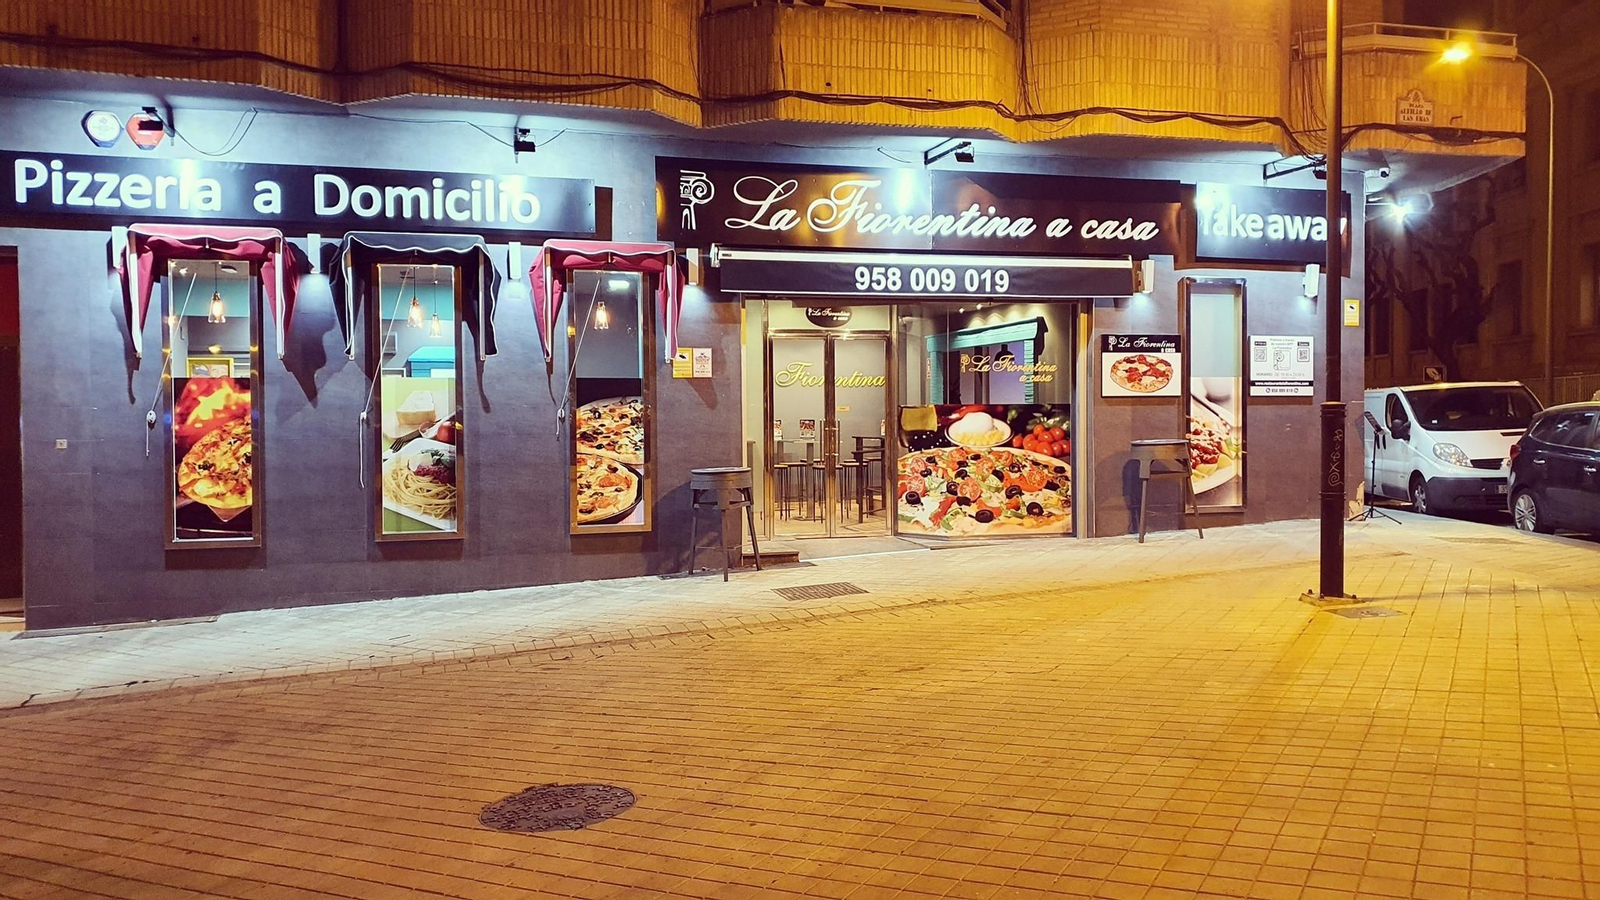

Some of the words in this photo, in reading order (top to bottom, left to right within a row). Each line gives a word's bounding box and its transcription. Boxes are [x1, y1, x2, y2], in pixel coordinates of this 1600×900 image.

[14, 158, 222, 211] Pizzeria
[253, 180, 281, 214] a
[313, 174, 541, 223] Domicilio
[724, 176, 801, 231] La
[806, 180, 1036, 238] Fiorentina
[1045, 217, 1072, 238] a
[1080, 217, 1159, 241] casa
[1198, 203, 1264, 239] Take
[855, 266, 902, 291] 958
[909, 267, 956, 292] 009
[964, 269, 1010, 293] 019
[1117, 336, 1131, 348] La
[1133, 337, 1175, 348] Fiorentina
[968, 354, 991, 372] La
[991, 354, 1058, 373] Fiorentina
[1019, 374, 1027, 382] a
[1030, 374, 1053, 382] casa
